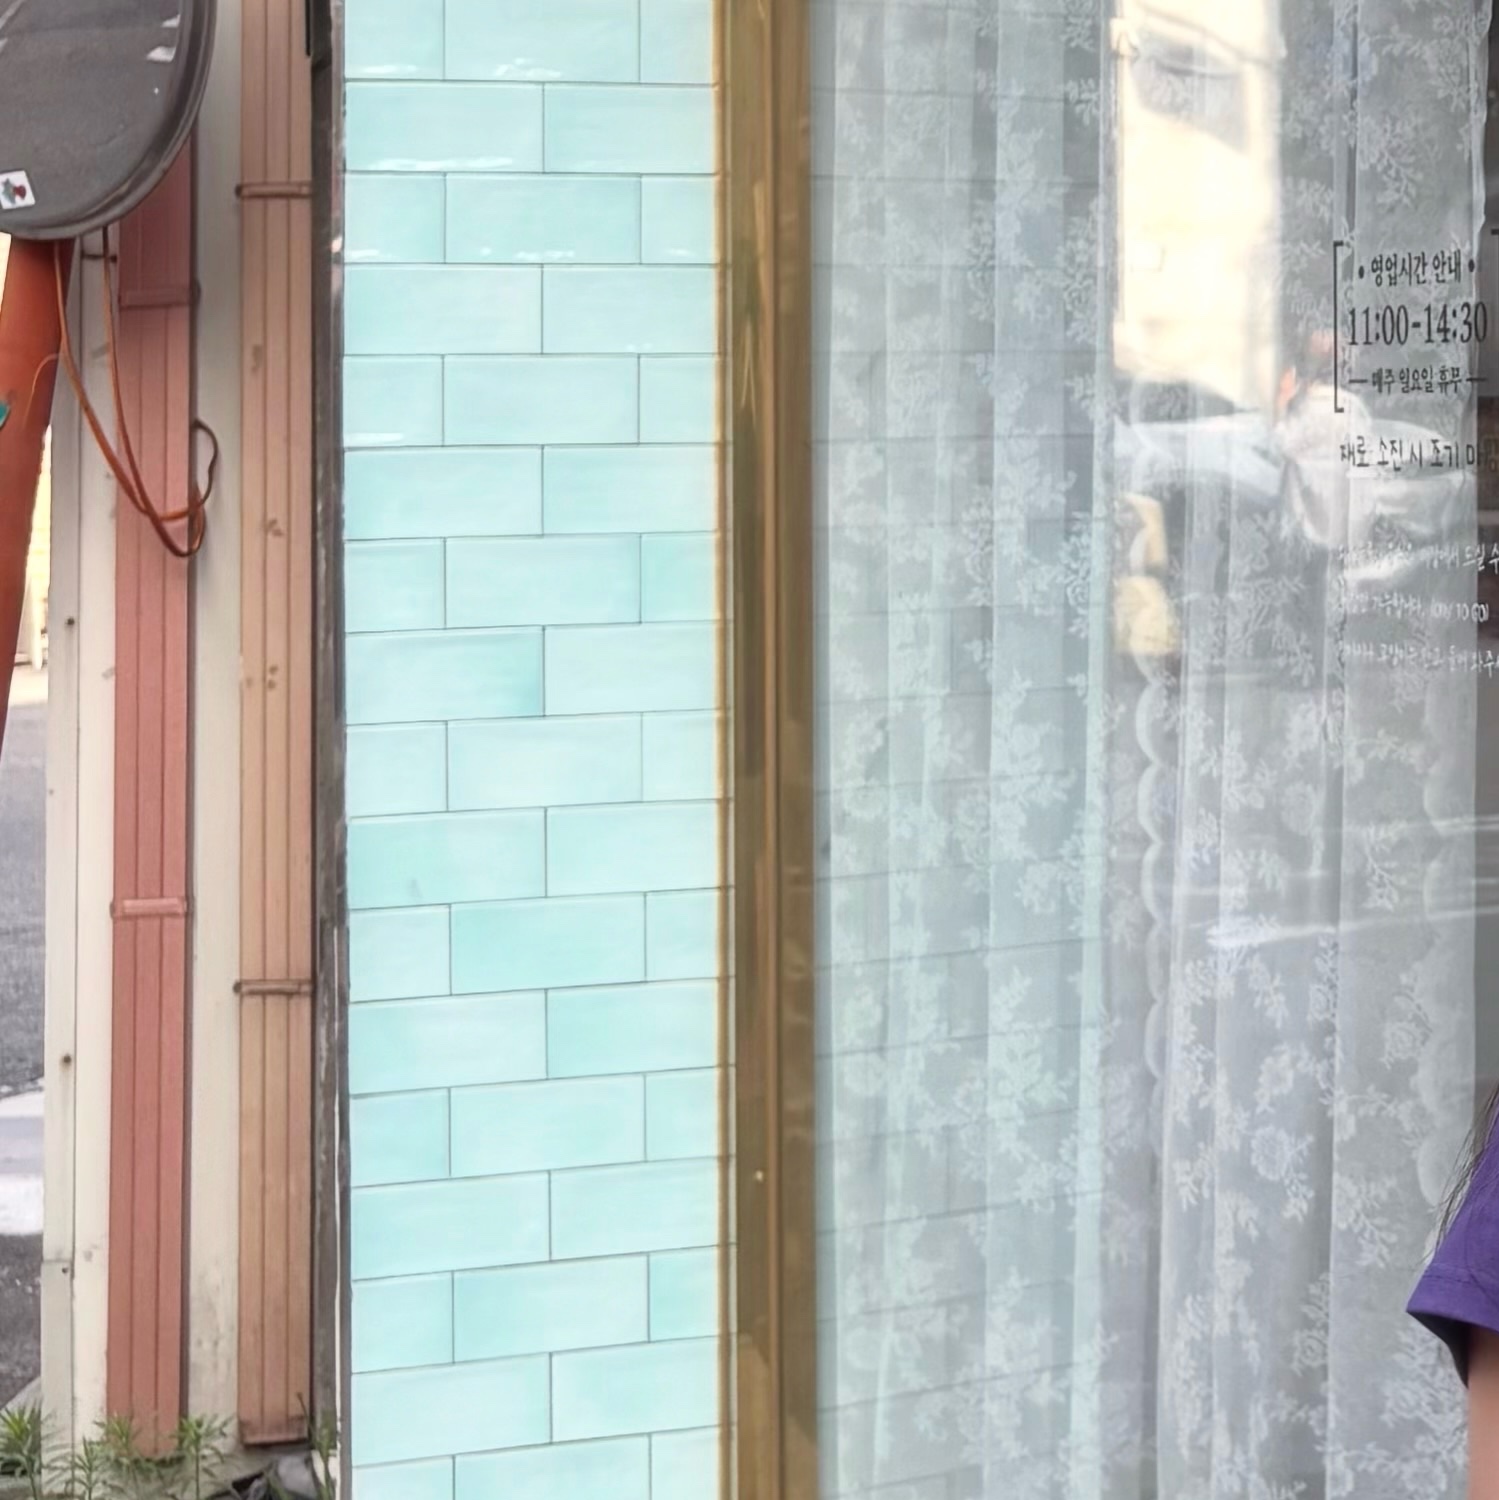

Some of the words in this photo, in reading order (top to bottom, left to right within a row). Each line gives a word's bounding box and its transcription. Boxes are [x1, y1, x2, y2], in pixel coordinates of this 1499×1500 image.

[1371, 253, 1428, 287] 영업시간
[1432, 248, 1461, 284] 안내
[1349, 301, 1488, 346] 11:00-14:30
[1371, 367, 1395, 394] 매주
[1399, 365, 1434, 394] 일요일
[1437, 365, 1462, 395] 휴무
[1340, 436, 1369, 467] 재료
[1377, 436, 1402, 471] 소진
[1410, 440, 1423, 469] 시
[1431, 439, 1459, 468] 조기
[1462, 543, 1485, 571] 드실
